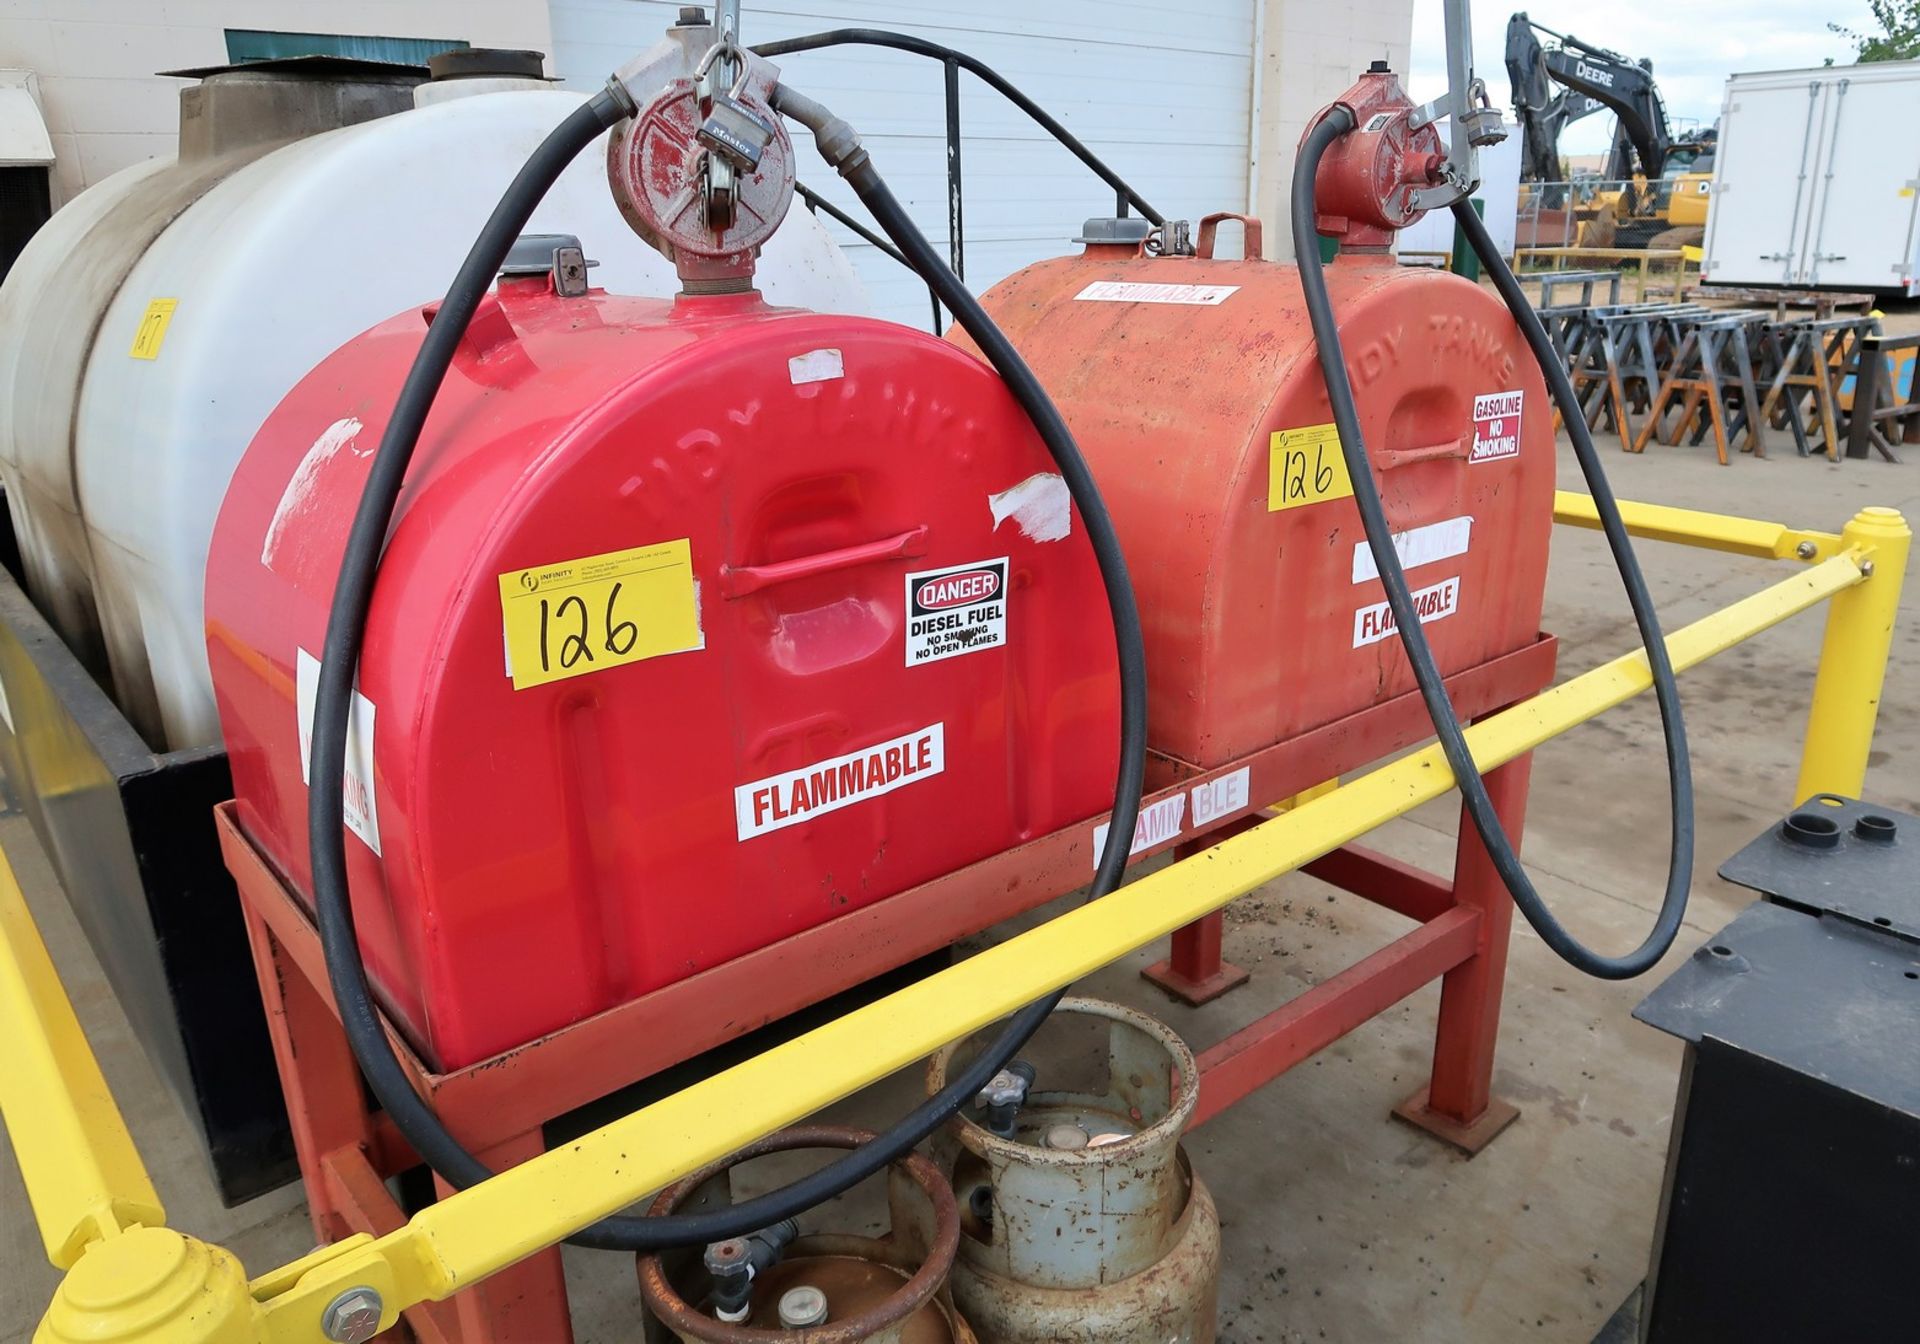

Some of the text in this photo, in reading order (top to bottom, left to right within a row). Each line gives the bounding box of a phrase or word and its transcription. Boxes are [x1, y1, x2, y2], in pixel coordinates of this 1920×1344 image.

[1576, 61, 1614, 88] DEERE
[712, 126, 751, 155] Master
[1476, 396, 1520, 418] GASOLINE
[1489, 419, 1503, 438] NO
[1473, 435, 1515, 458] SMOKING
[1283, 444, 1333, 503] 126
[540, 569, 574, 580] INFINITY
[923, 574, 995, 606] DANGER
[911, 605, 1003, 637] DIESEL FUEL
[1362, 585, 1453, 639] FLAABLE
[540, 582, 638, 672] 126
[927, 625, 988, 646] NO SMING
[916, 634, 998, 660] NO OPEN FLAMES
[753, 735, 931, 827] FLAMMABLE
